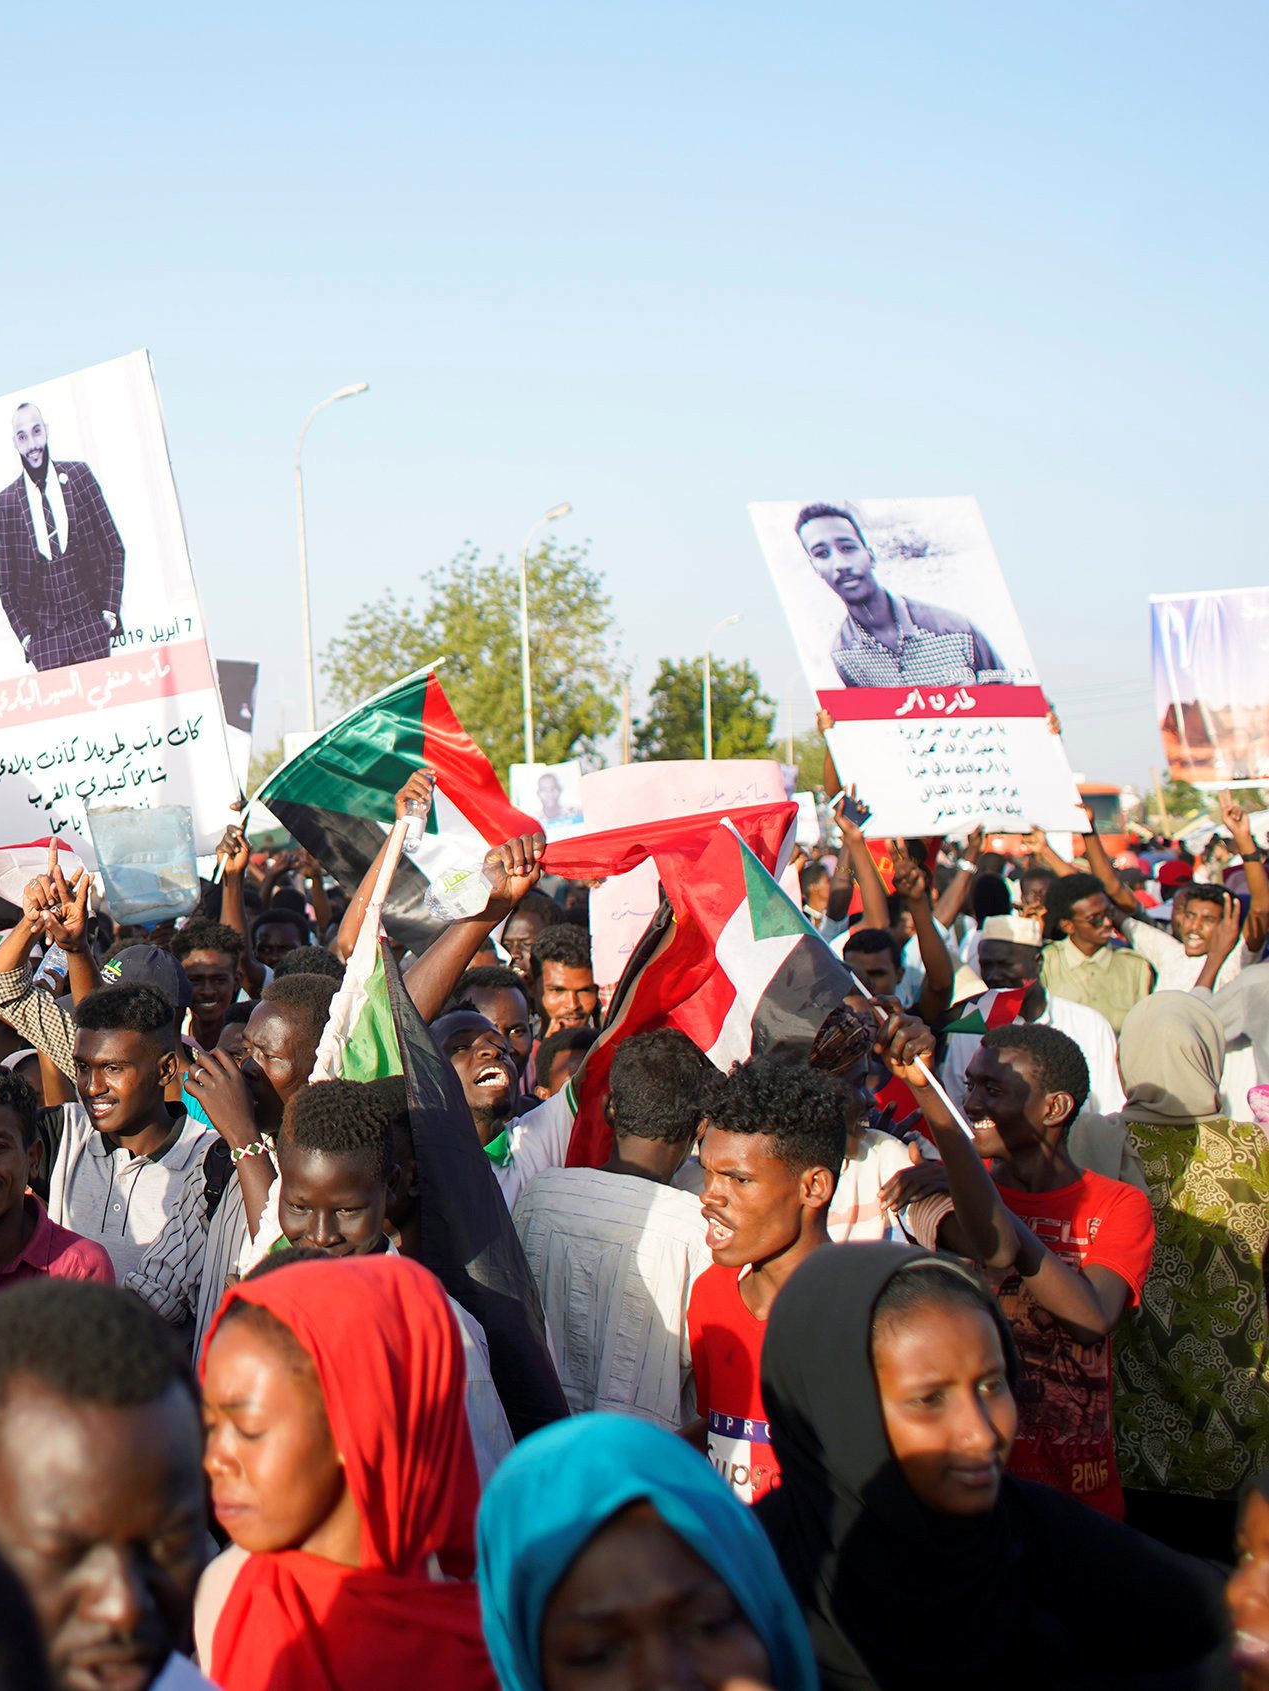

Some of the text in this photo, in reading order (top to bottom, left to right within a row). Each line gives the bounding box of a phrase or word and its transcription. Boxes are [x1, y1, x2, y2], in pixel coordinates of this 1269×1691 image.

[111, 617, 193, 648] 7 أبريل 2019
[927, 687, 977, 716] طارق
[166, 715, 204, 747] كان
[1071, 1459, 1110, 1494] 2016
